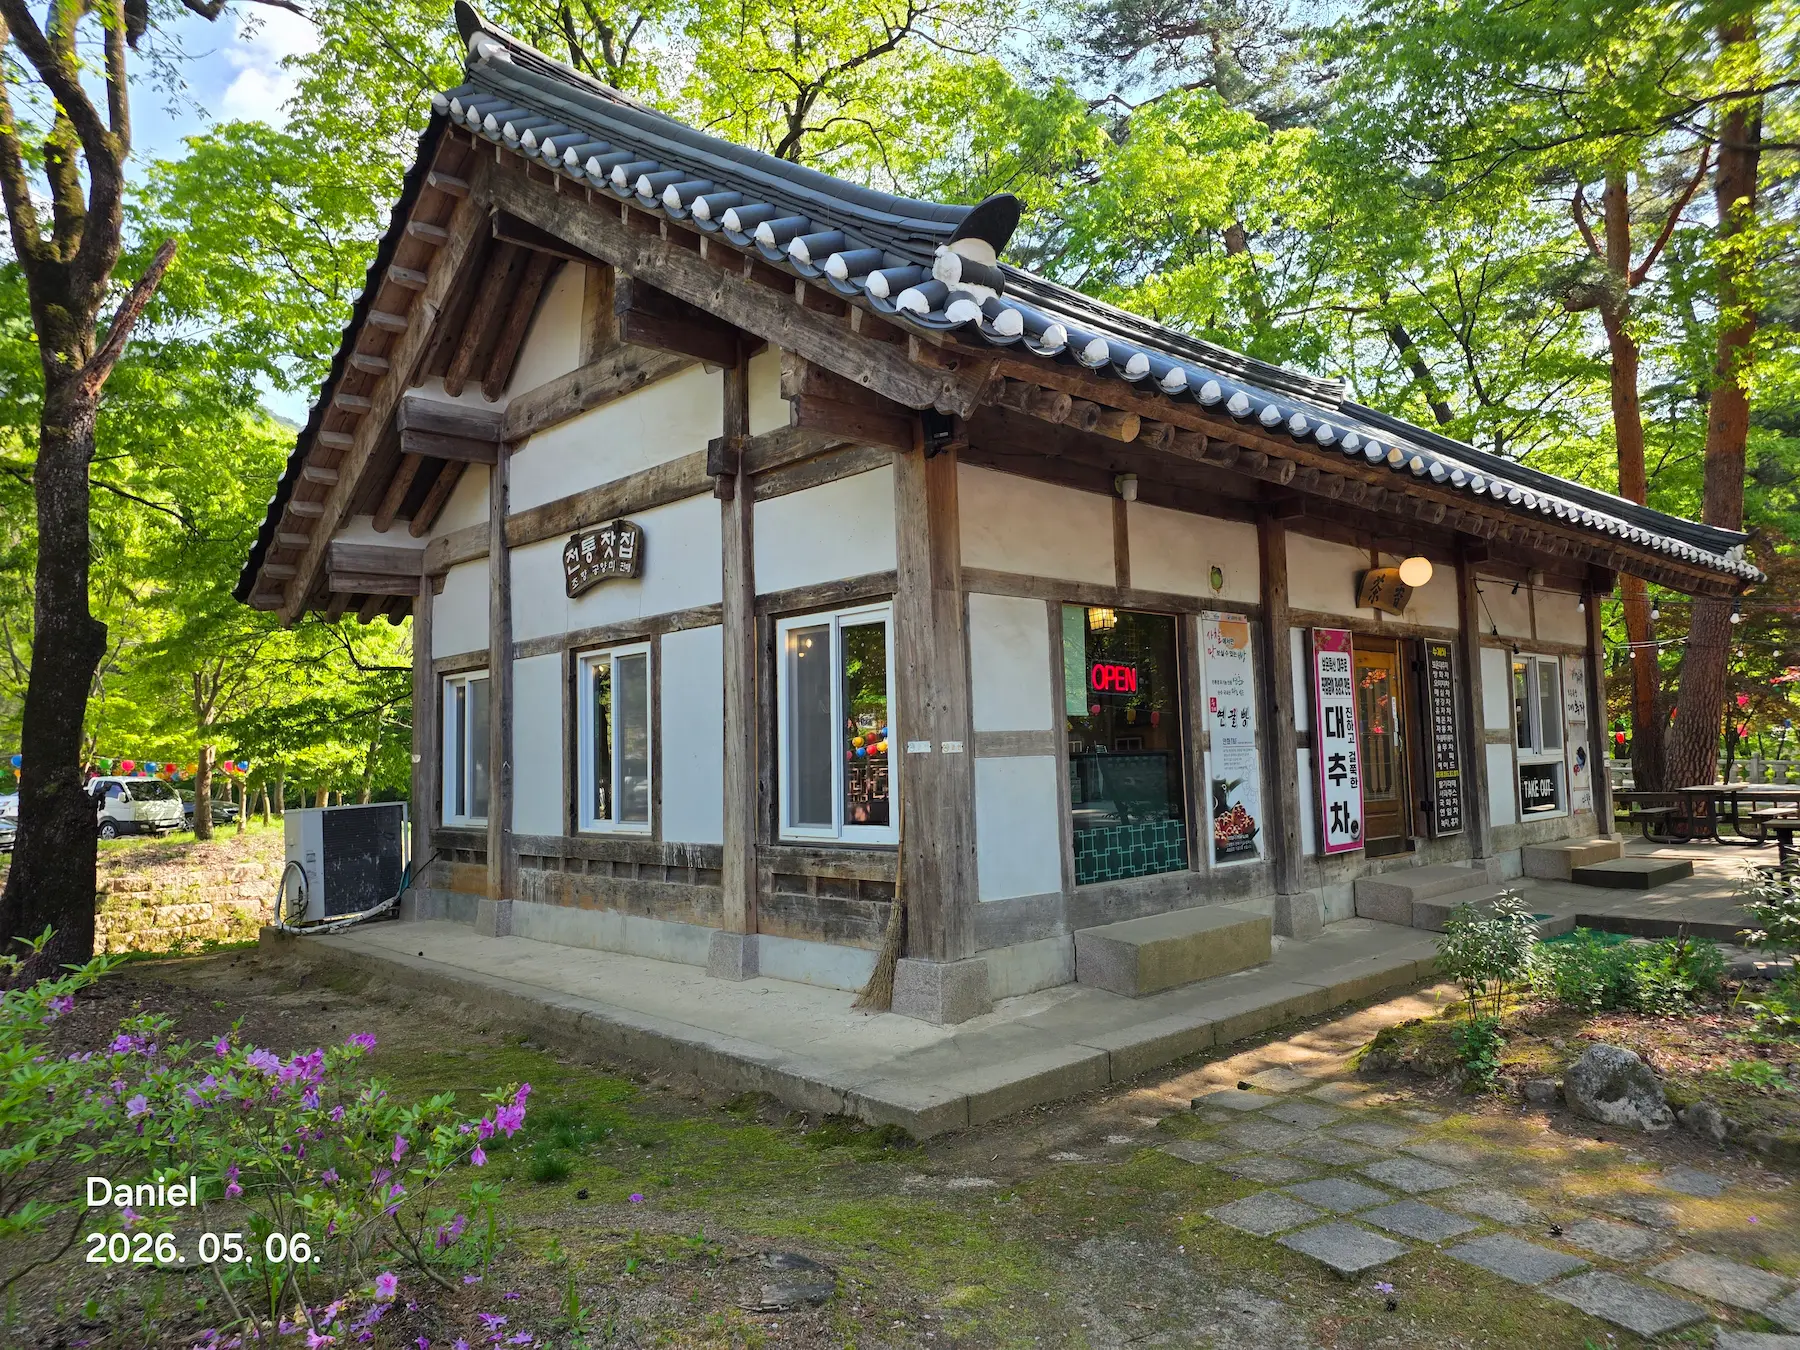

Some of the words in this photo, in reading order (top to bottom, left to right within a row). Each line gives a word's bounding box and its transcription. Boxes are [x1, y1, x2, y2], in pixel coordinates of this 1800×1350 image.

[566, 531, 635, 575] 전통찻집
[592, 560, 616, 576] 공양미
[1091, 663, 1137, 691] OPEN
[1345, 707, 1356, 744] 진하고
[1325, 706, 1350, 834] 대추차
[1348, 751, 1359, 789] 걸쭉한
[1523, 778, 1539, 799] TAKE
[1540, 778, 1551, 798] OUT
